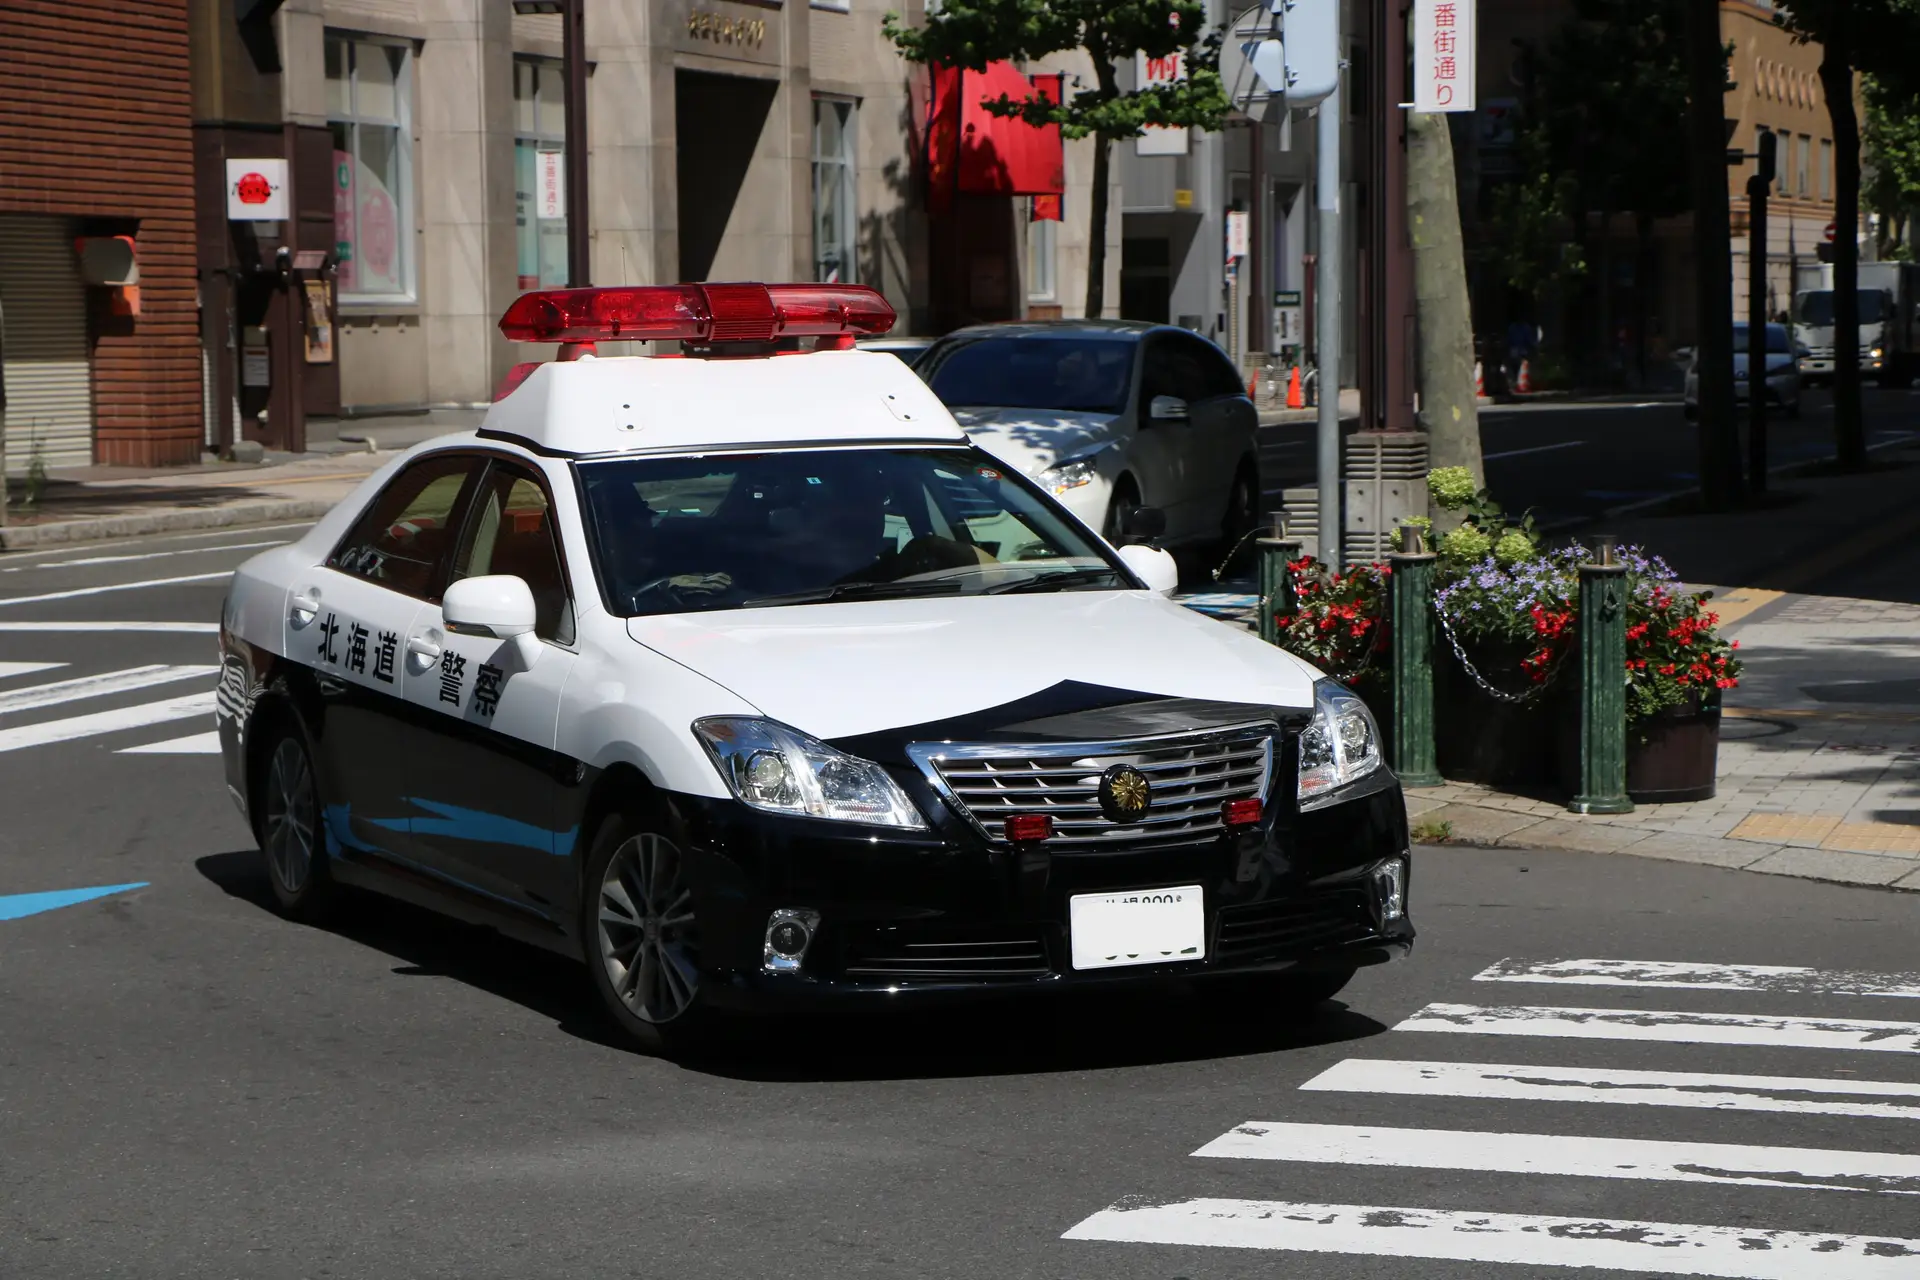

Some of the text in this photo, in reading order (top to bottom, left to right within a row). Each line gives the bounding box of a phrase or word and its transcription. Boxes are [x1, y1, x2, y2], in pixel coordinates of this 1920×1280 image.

[1433, 2, 1457, 106] 番街通り
[317, 612, 504, 717] 北海道 警察
